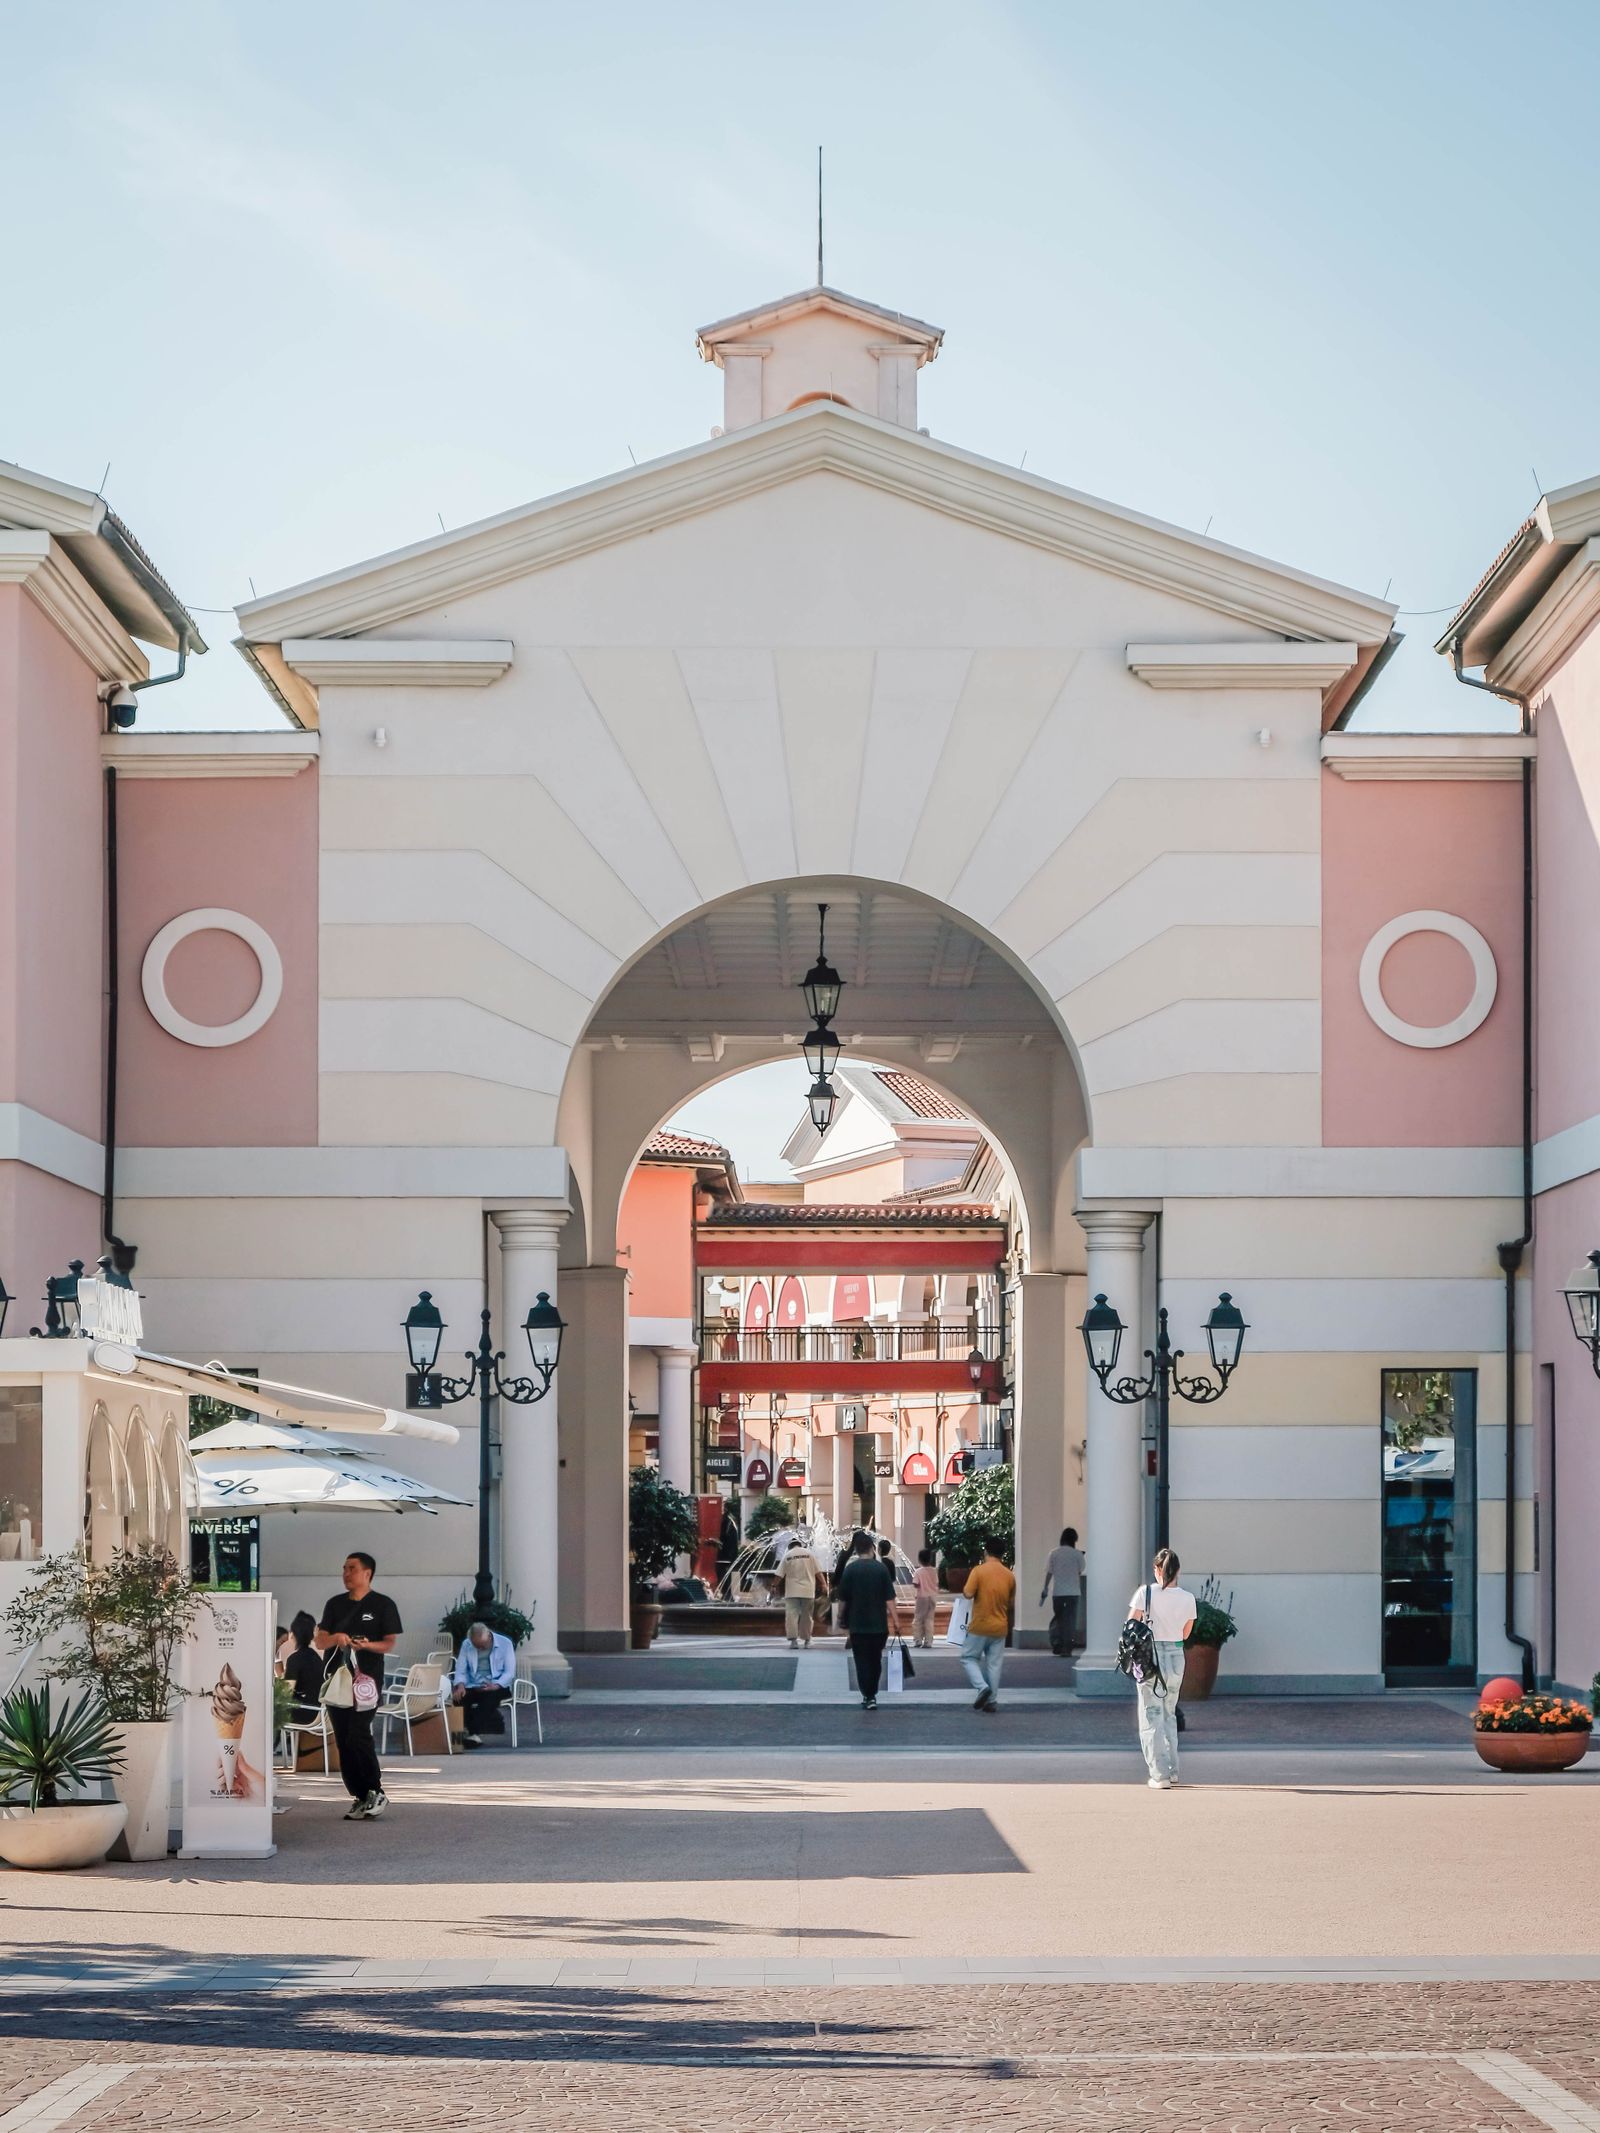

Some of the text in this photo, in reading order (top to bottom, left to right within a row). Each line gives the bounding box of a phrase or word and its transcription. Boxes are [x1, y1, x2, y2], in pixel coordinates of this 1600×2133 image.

[706, 1458, 730, 1467] AIGLE
[874, 1463, 890, 1475] Lee
[190, 1523, 250, 1534] NVERSE
